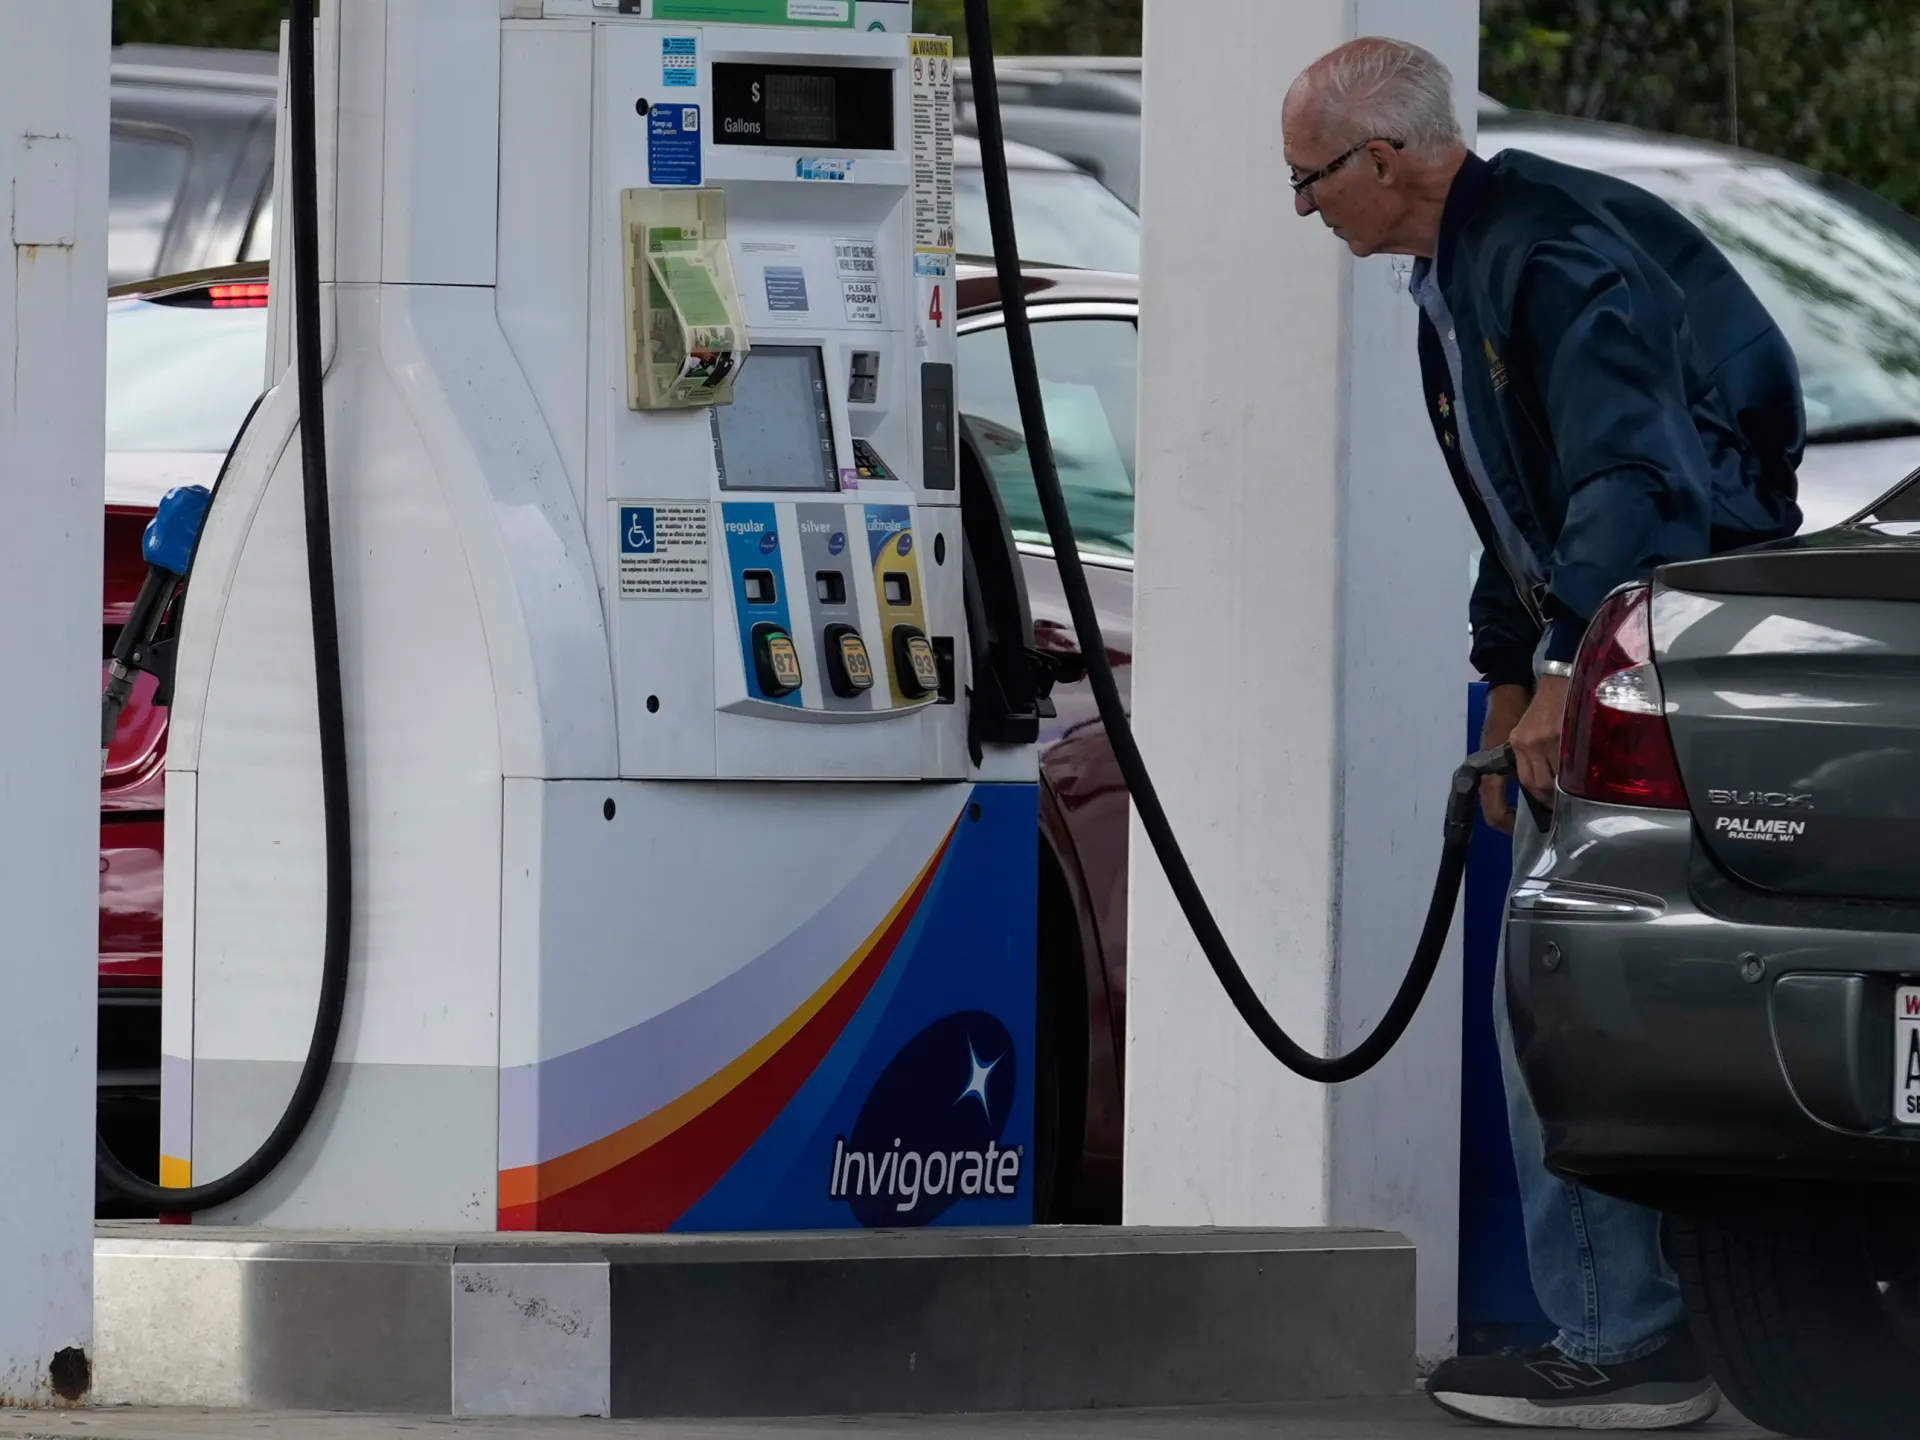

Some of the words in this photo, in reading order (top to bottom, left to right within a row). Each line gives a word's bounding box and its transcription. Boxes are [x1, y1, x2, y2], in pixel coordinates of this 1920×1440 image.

[919, 41, 948, 56] WARNING
[751, 81, 761, 103] $
[724, 117, 761, 134] Gallons
[848, 284, 872, 293] PLEASE
[845, 294, 877, 304] PREPAY
[929, 285, 942, 328] 4
[725, 520, 764, 536] regular
[801, 520, 831, 533] silver
[867, 519, 901, 532] ultimate
[774, 653, 796, 674] 87
[847, 654, 868, 673] 89
[913, 654, 934, 675] 93
[1708, 789, 1815, 810] BUICK
[1715, 816, 1806, 835] PALMEN
[1728, 831, 1777, 842] RACINE,
[1779, 834, 1795, 842] WI
